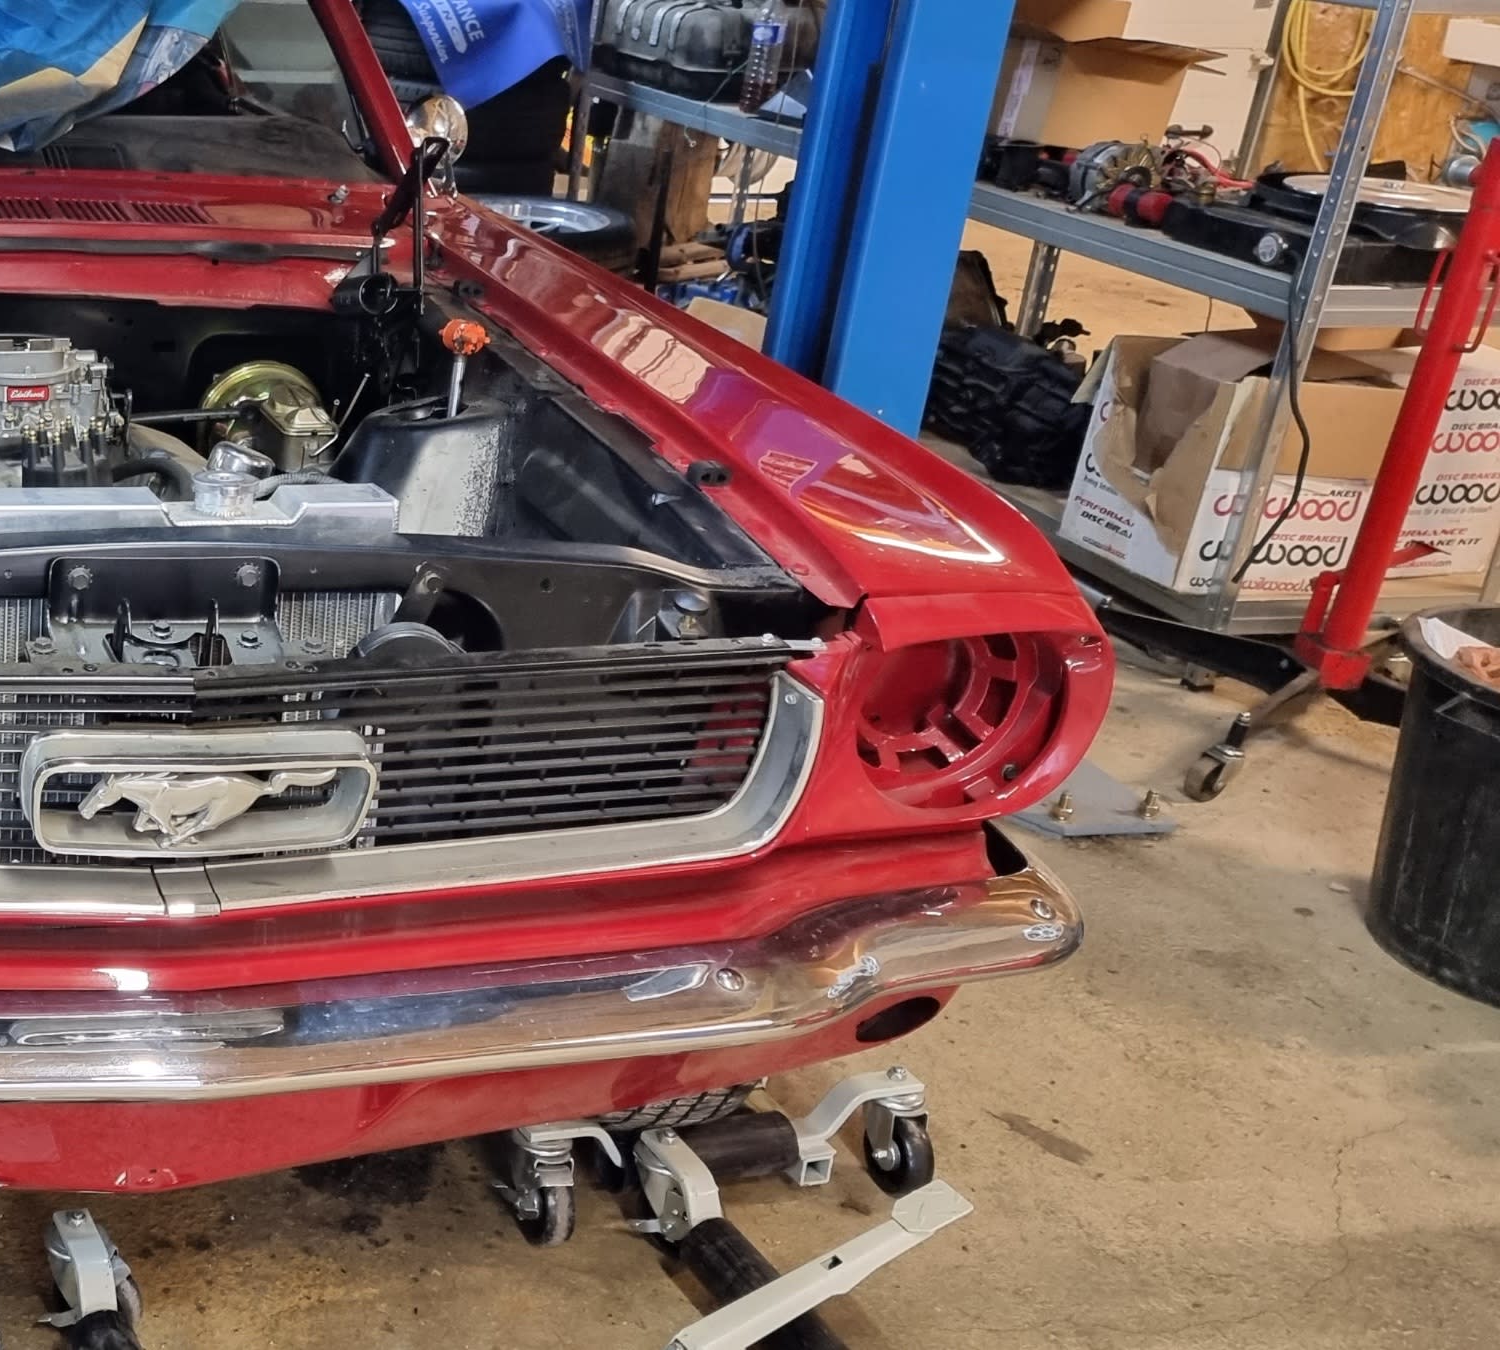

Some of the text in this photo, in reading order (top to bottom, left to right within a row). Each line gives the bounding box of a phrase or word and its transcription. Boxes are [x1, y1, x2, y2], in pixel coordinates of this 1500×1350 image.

[452, 0, 485, 42] ANCE
[1329, 489, 1358, 498] AKES
[1074, 495, 1135, 528] PERFORMA
[1104, 521, 1133, 540] BRA
[1298, 534, 1343, 543] BRAKES
